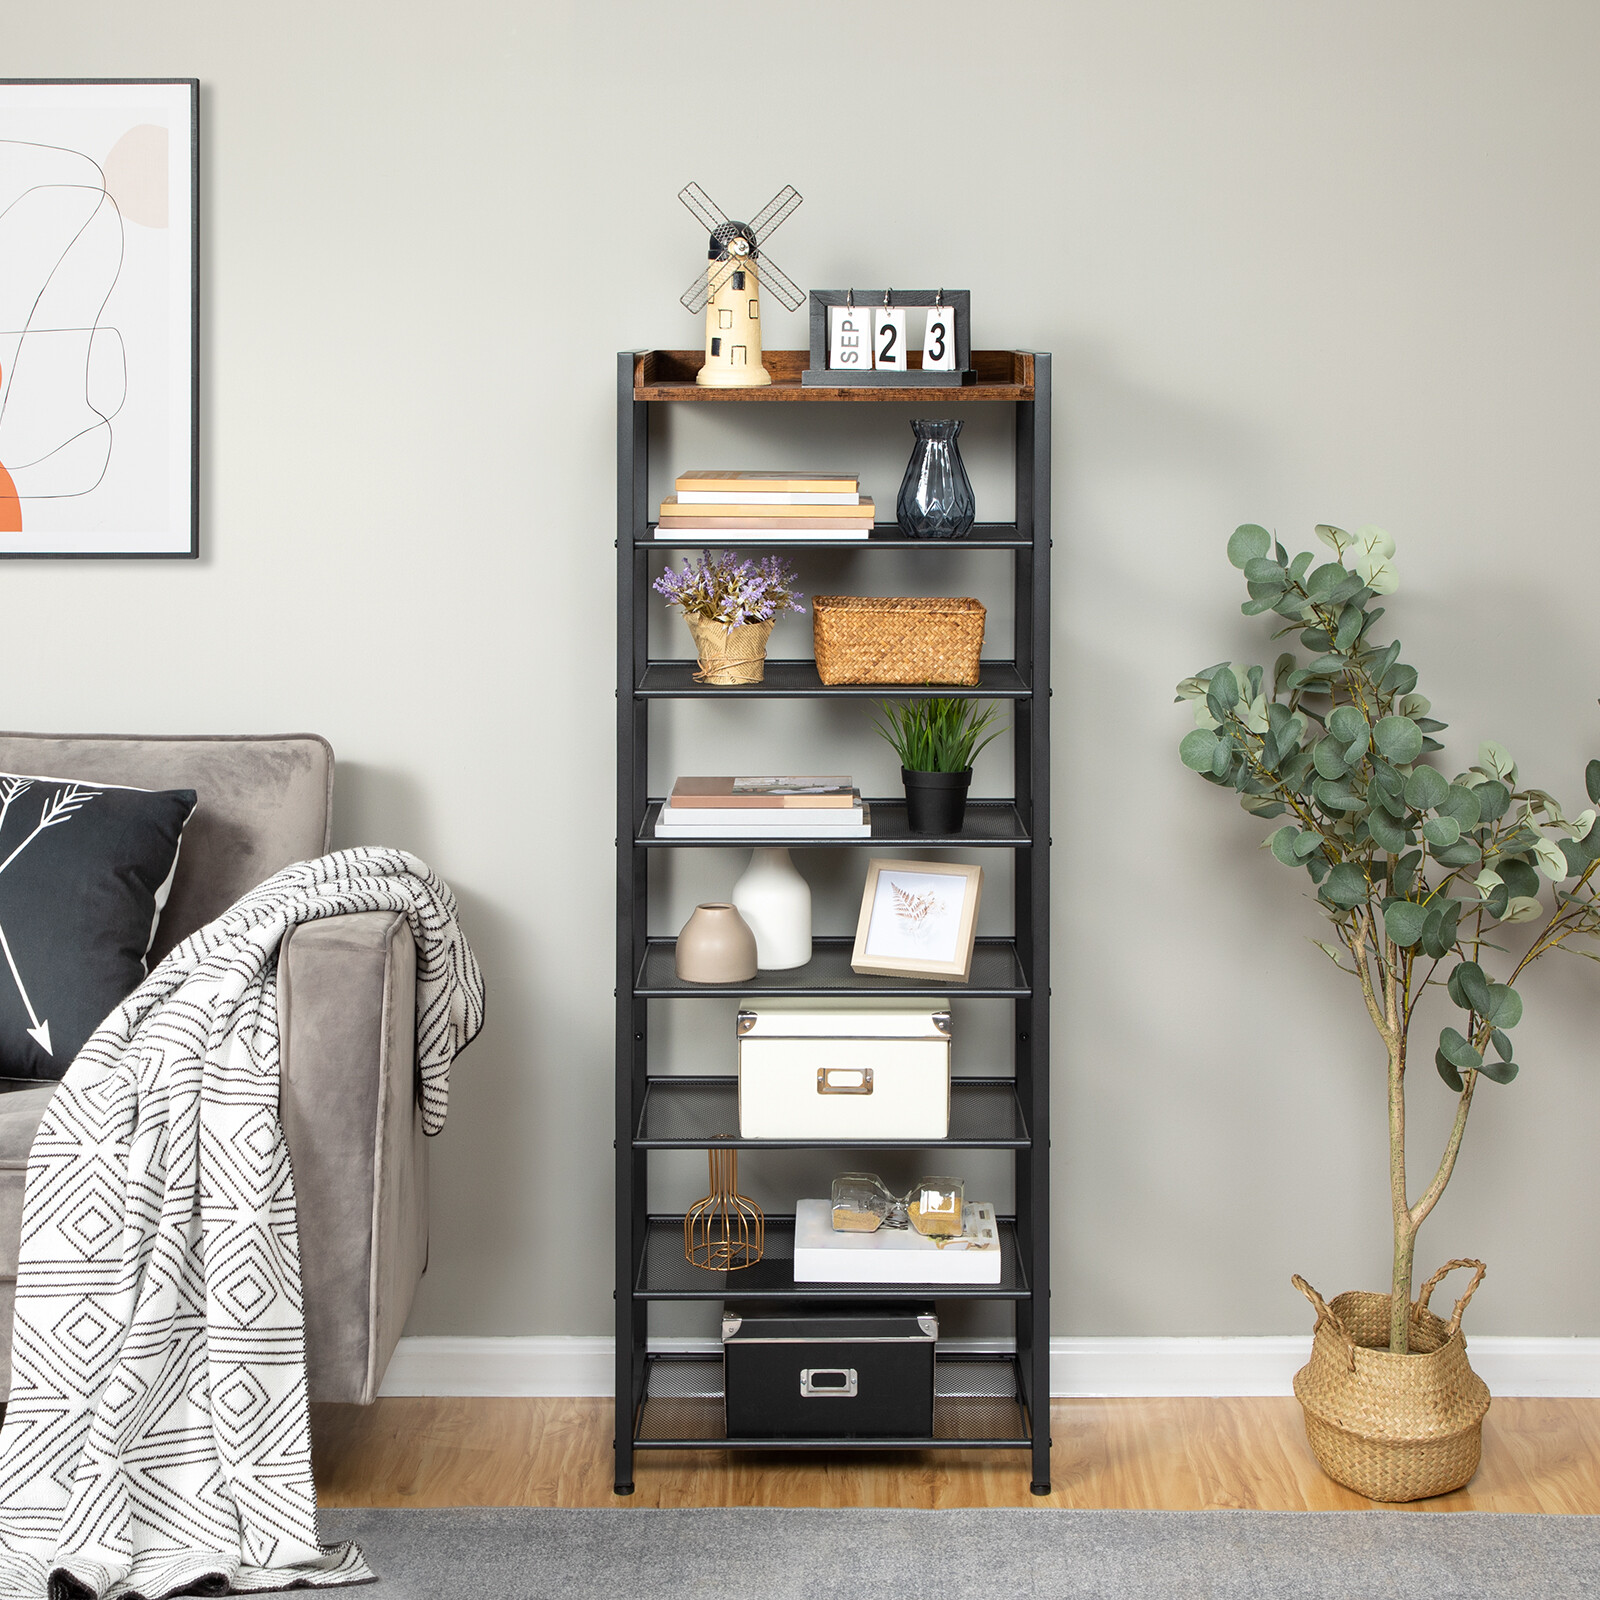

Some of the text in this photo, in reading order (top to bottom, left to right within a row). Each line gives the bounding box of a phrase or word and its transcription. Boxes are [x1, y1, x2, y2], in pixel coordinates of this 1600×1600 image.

[840, 320, 945, 364] SEP 2 3
